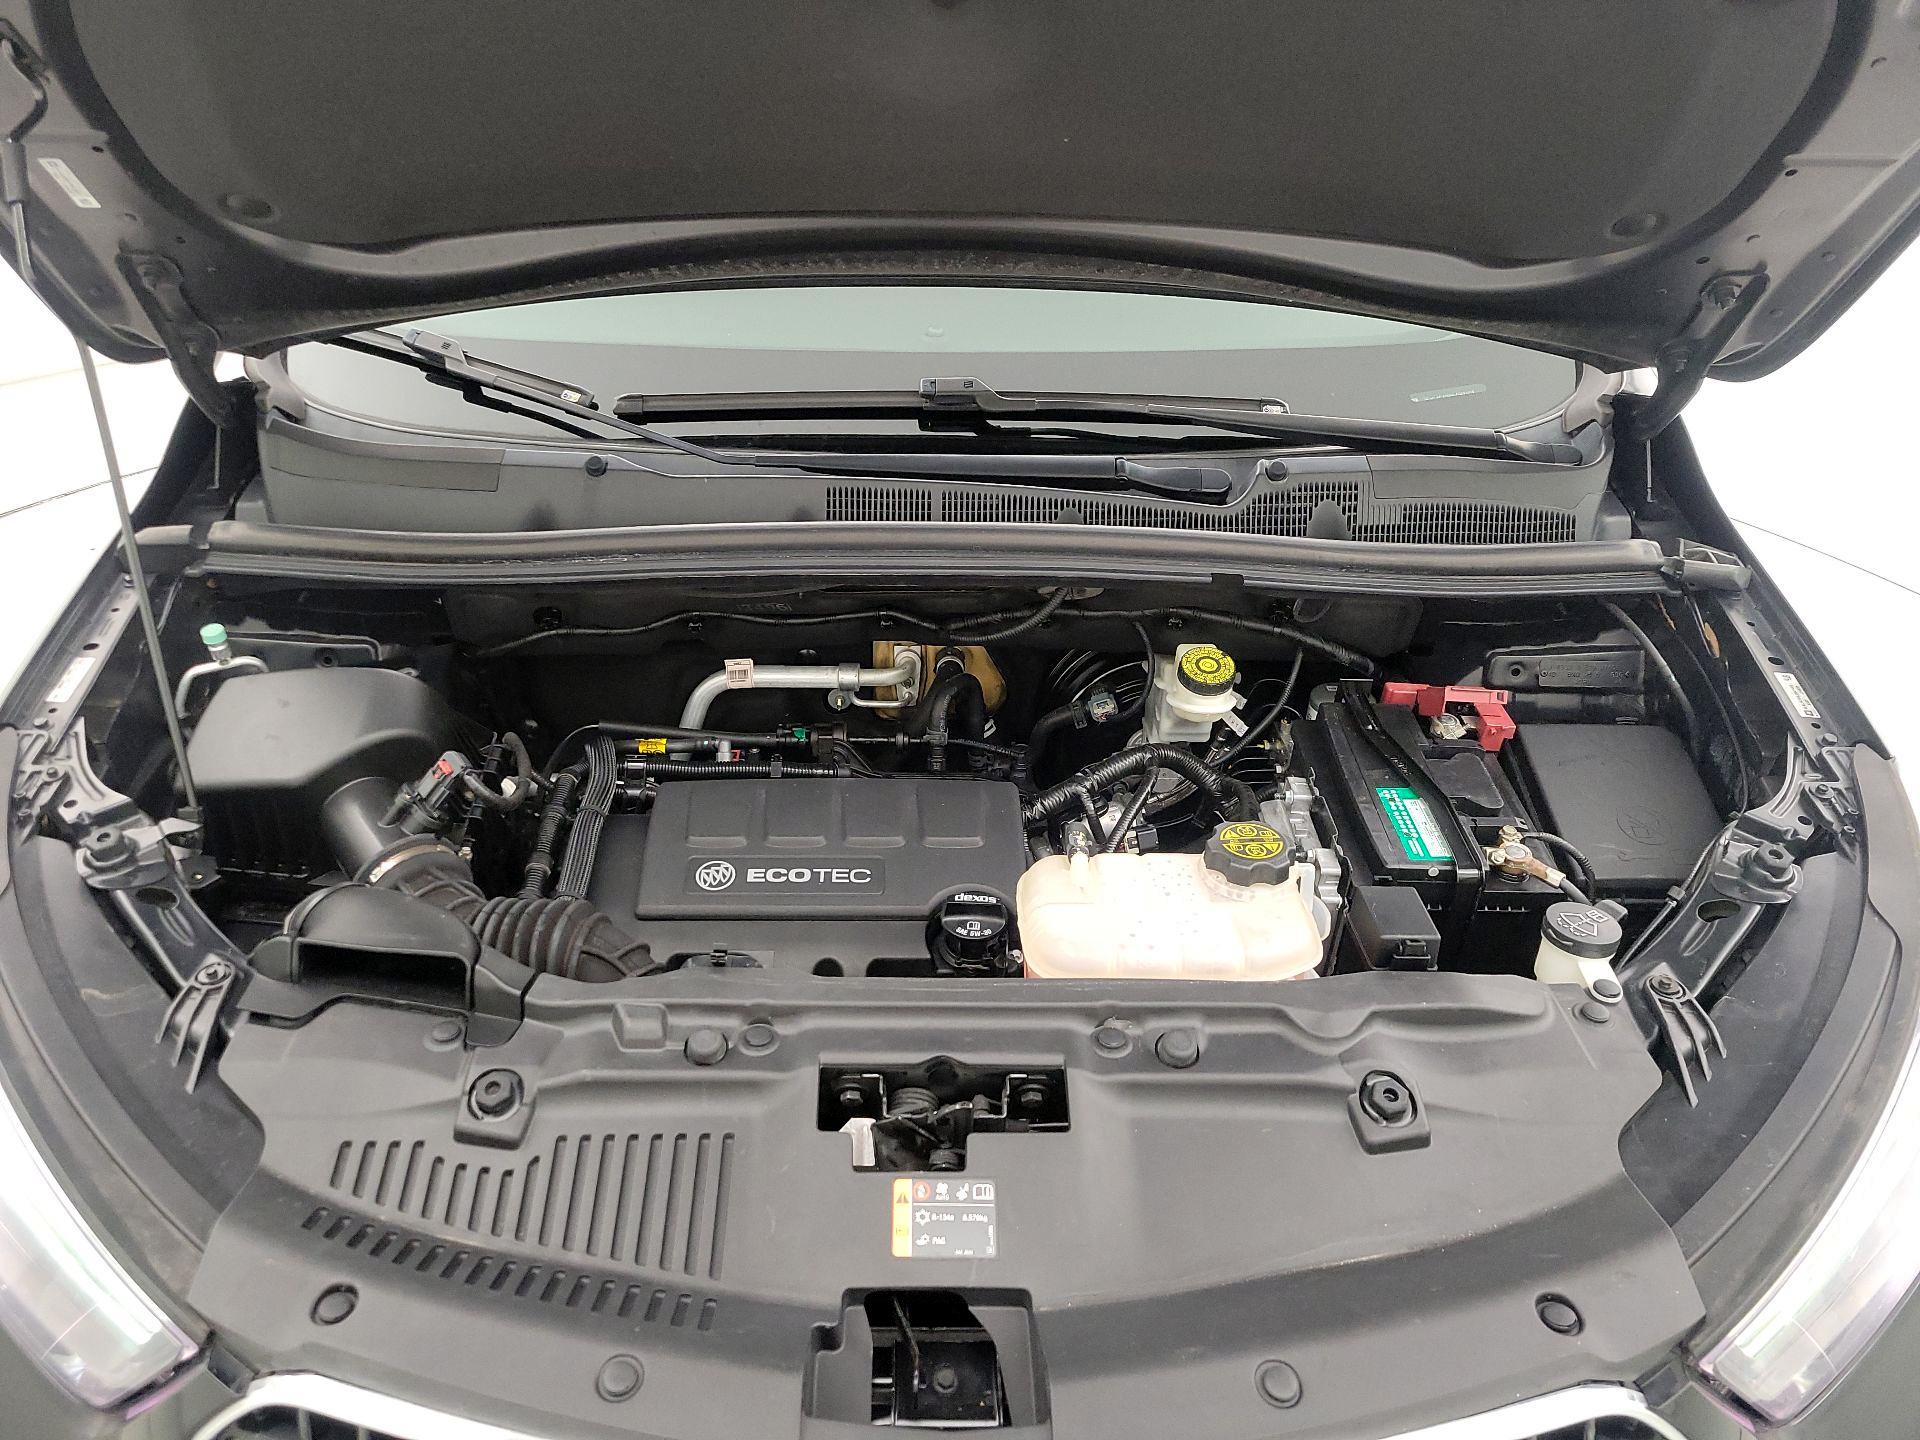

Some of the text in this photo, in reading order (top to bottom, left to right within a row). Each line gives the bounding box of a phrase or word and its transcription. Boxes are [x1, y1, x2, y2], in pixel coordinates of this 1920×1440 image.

[746, 868, 872, 883] ECOTEC
[955, 893, 997, 903] dexos
[956, 927, 992, 937] SAE 5W-30
